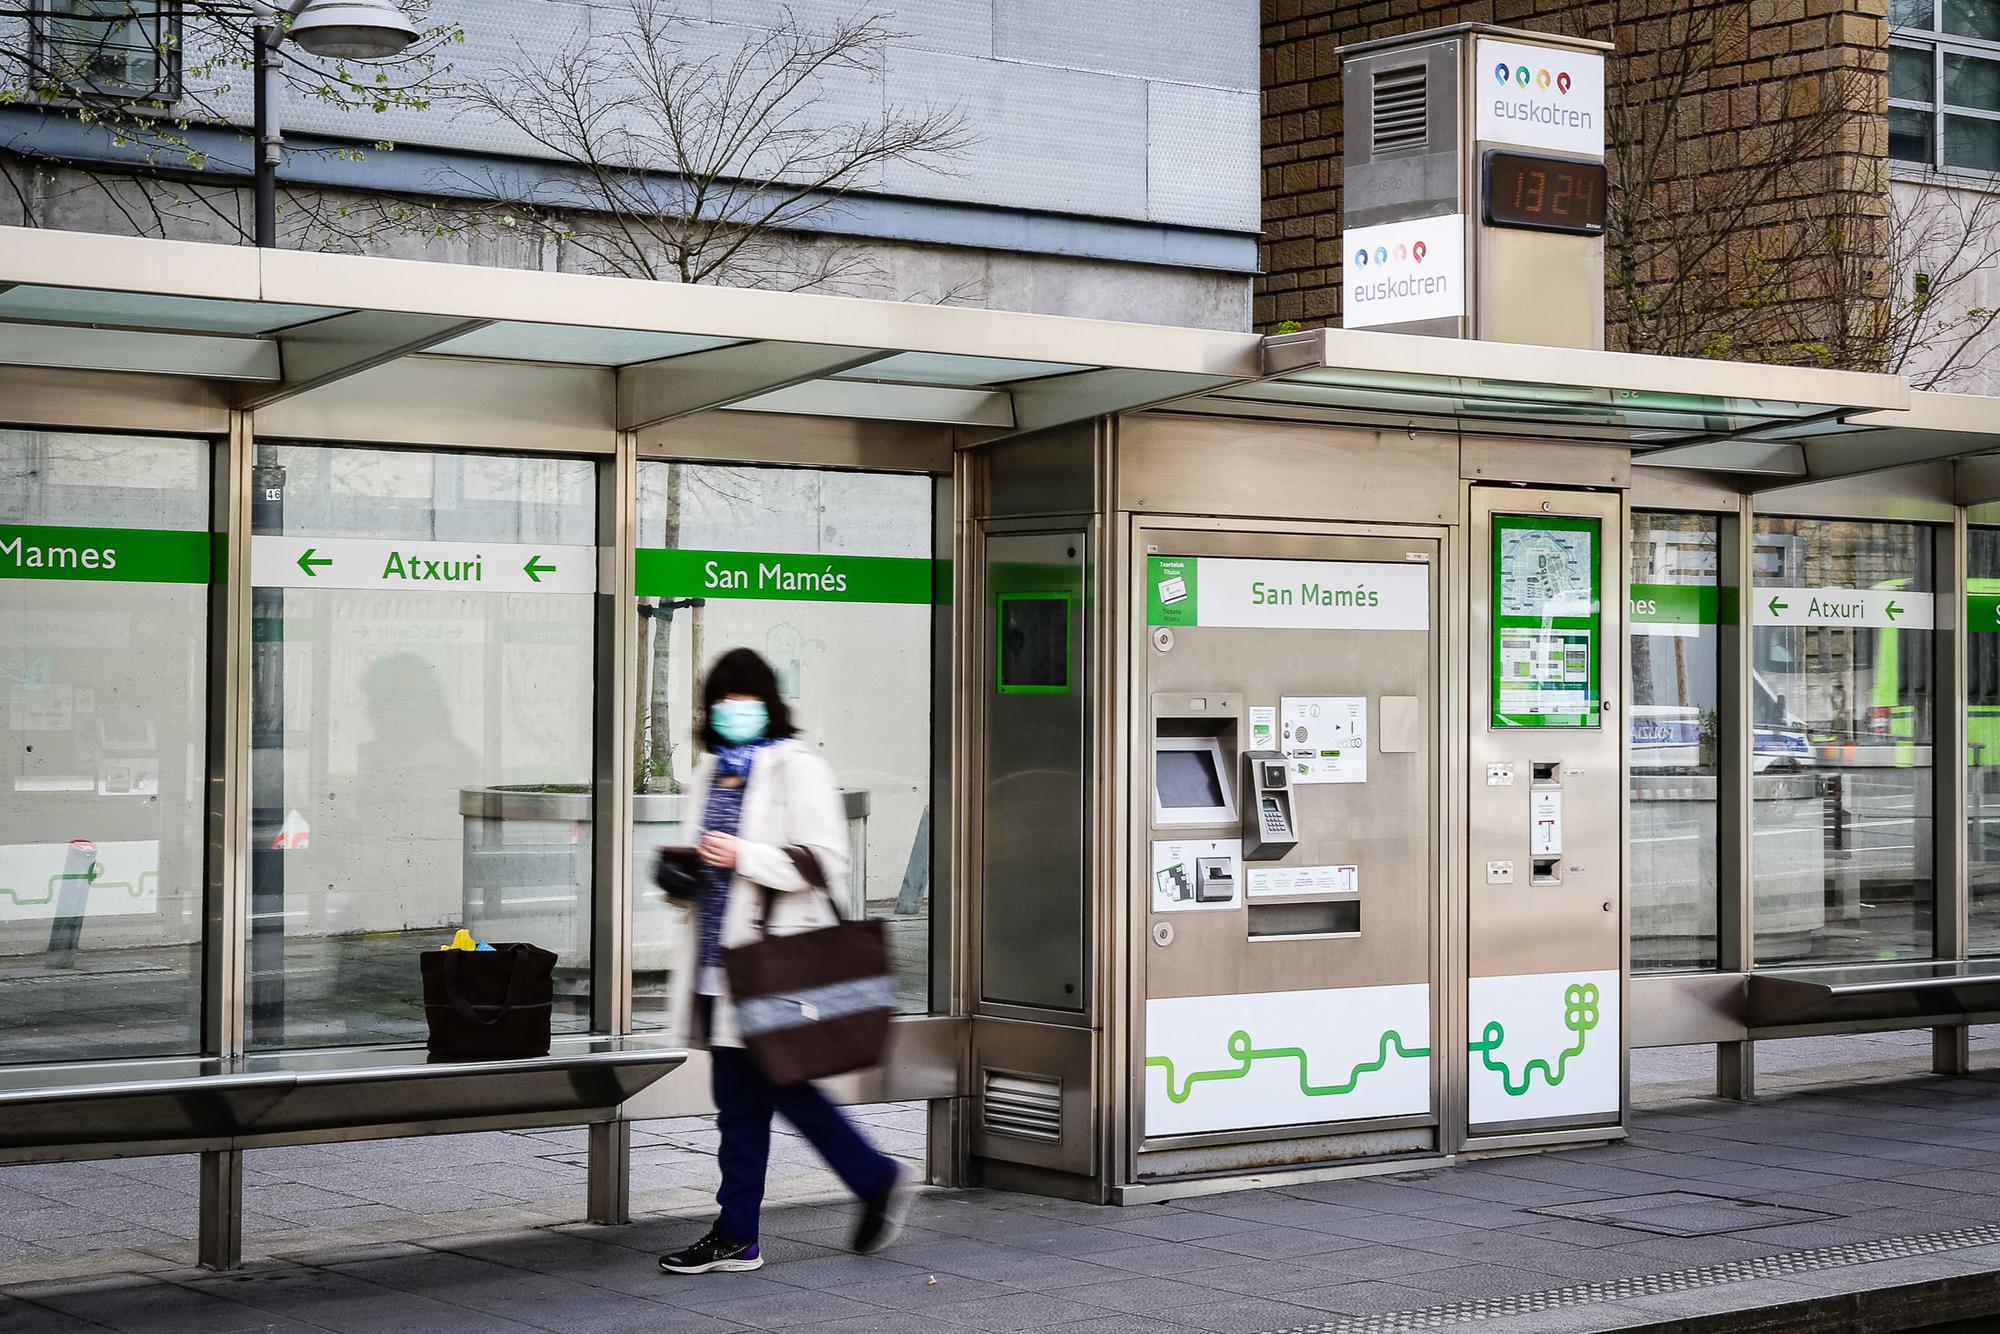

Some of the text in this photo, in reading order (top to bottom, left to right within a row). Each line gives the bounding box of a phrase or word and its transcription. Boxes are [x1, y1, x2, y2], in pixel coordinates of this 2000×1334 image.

[1494, 99, 1592, 130] euskotren
[1354, 273, 1447, 302] euskotren
[267, 489, 281, 500] 46
[382, 551, 482, 581] Atxuri
[704, 560, 847, 592] San Mamés
[1252, 581, 1378, 607] San Mamés
[1808, 597, 1864, 618] Atxuri
